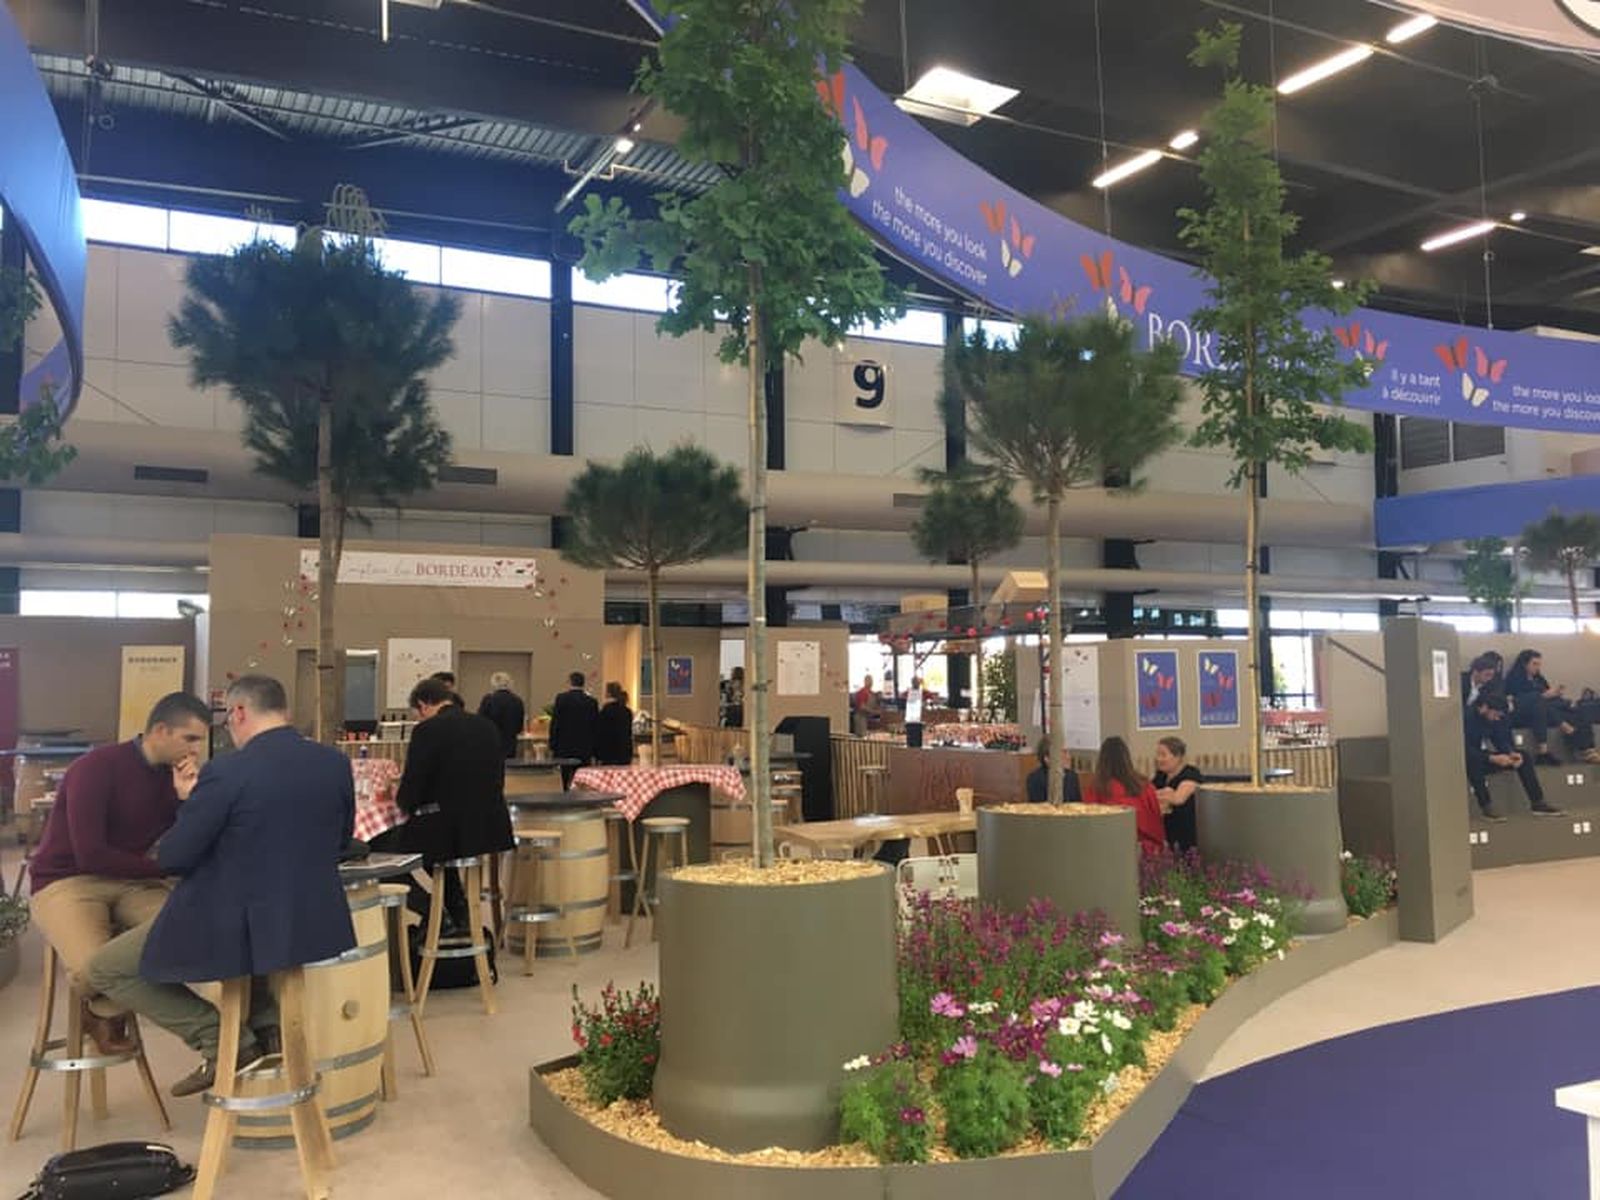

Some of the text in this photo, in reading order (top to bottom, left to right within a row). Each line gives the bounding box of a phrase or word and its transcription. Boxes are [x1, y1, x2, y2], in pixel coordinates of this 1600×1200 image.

[894, 186, 988, 261] the more you look
[872, 199, 988, 286] the more you discover
[853, 360, 885, 409] 9
[1418, 373, 1441, 387] tant
[1512, 385, 1529, 398] the
[1532, 388, 1559, 401] more
[1561, 391, 1581, 405] you
[1492, 399, 1510, 413] the
[1511, 402, 1539, 416] more
[1541, 405, 1561, 419] you
[416, 563, 503, 578] BORDEAUX
